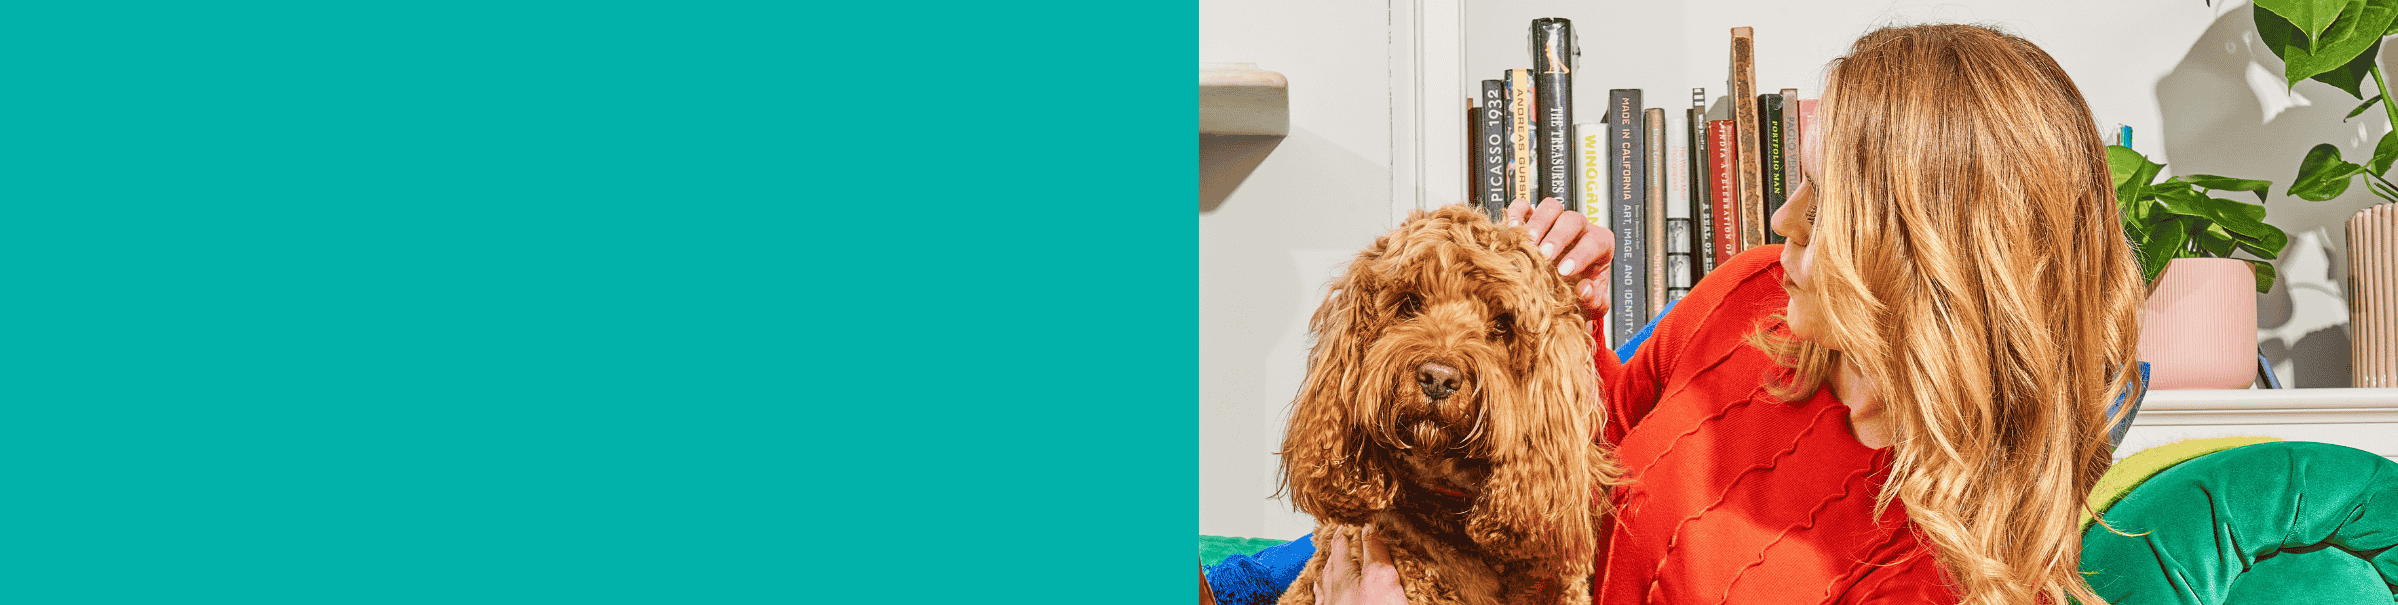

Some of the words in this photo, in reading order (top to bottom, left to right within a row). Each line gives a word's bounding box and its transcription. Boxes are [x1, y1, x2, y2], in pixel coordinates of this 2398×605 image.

[1487, 89, 1500, 126] 1932
[1517, 88, 1525, 151] ANDREAS
[1550, 106, 1564, 127] THE
[1621, 97, 1631, 125] MADE
[1622, 128, 1631, 139] IN
[1718, 129, 1727, 158] INDIA
[1771, 120, 1780, 171] PORTFOLIO
[1786, 116, 1797, 151] PAOLO
[1489, 134, 1504, 202] PICASSO
[1551, 129, 1565, 193] TREASURES
[1622, 142, 1632, 200] CALIFORNIA
[1773, 173, 1781, 194] MAN
[1622, 204, 1632, 225] ART,
[1721, 172, 1731, 239] CELEBRATION
[1623, 228, 1633, 262] IMAGE,
[1704, 242, 1712, 254] OF
[1725, 243, 1732, 256] OF
[1624, 264, 1633, 286] AND
